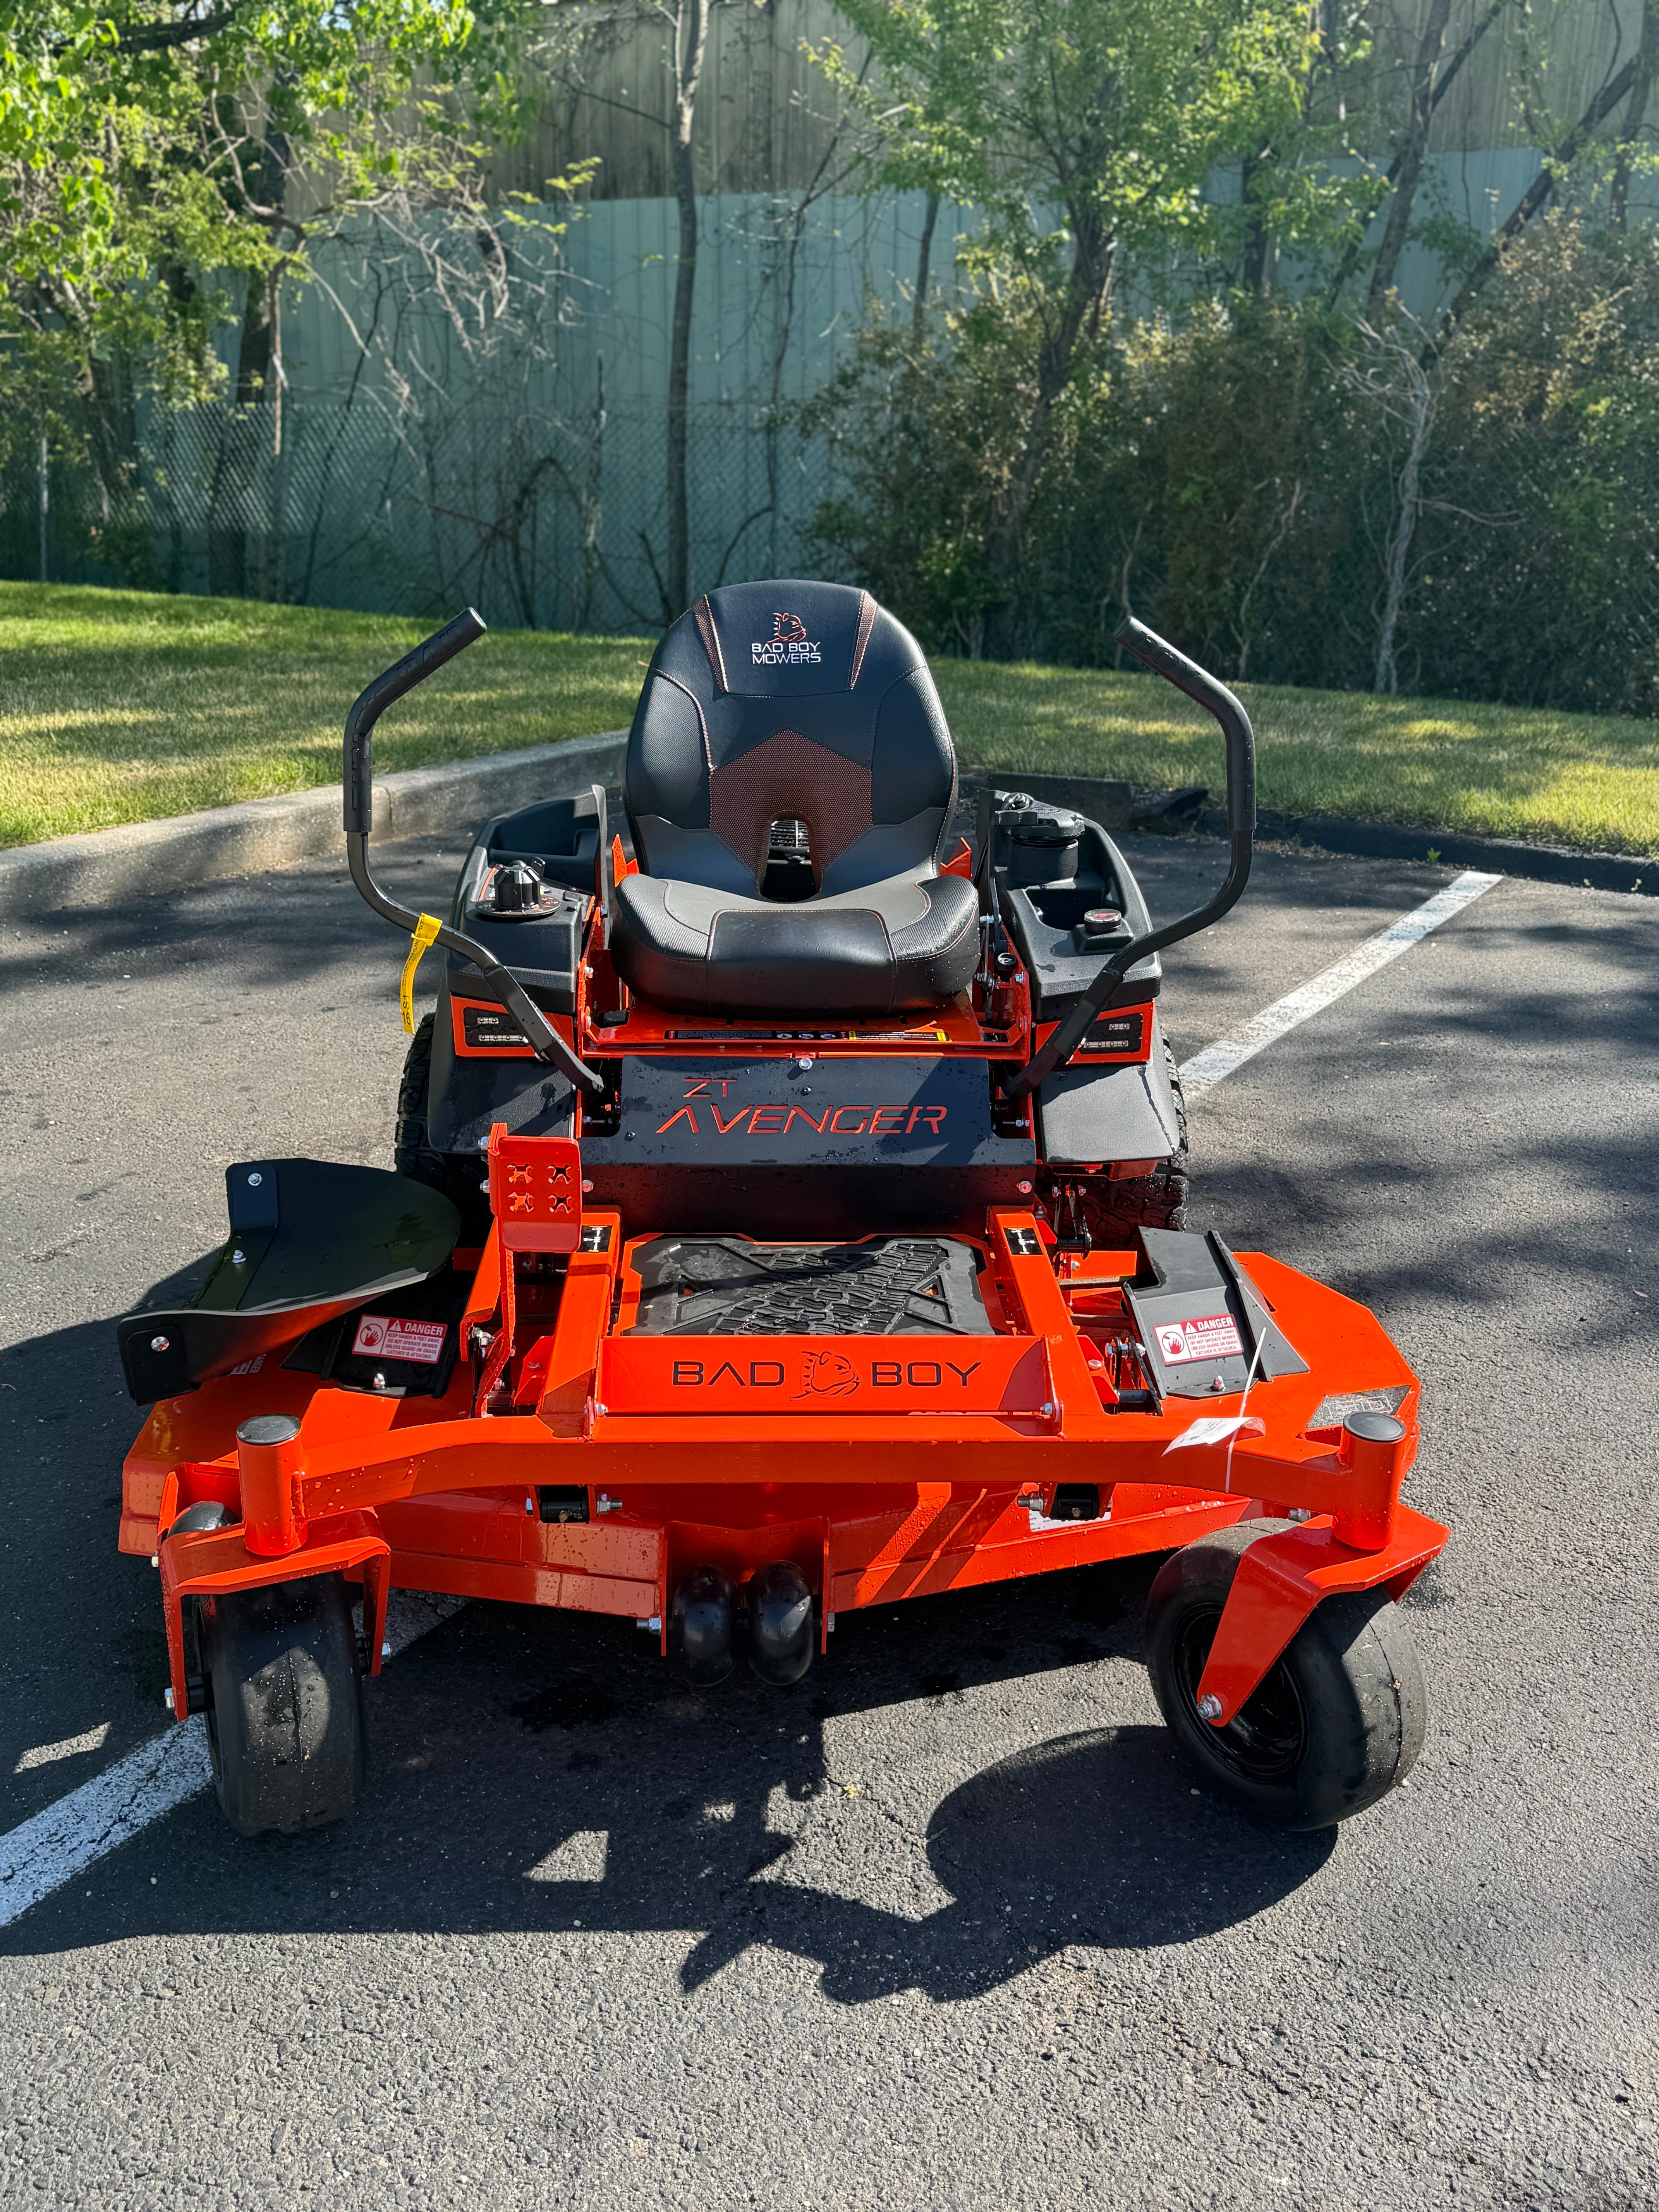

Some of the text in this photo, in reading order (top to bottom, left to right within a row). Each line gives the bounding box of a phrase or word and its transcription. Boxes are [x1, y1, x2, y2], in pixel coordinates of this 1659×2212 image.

[752, 642, 820, 653] BAD BOY
[752, 653, 821, 664] MOWERS
[683, 1078, 737, 1097] ZT
[656, 1104, 948, 1134] AVENGER
[404, 1322, 443, 1336] DANGER
[1197, 1317, 1234, 1331] DANGER
[673, 1360, 982, 1386] BAD BOY
